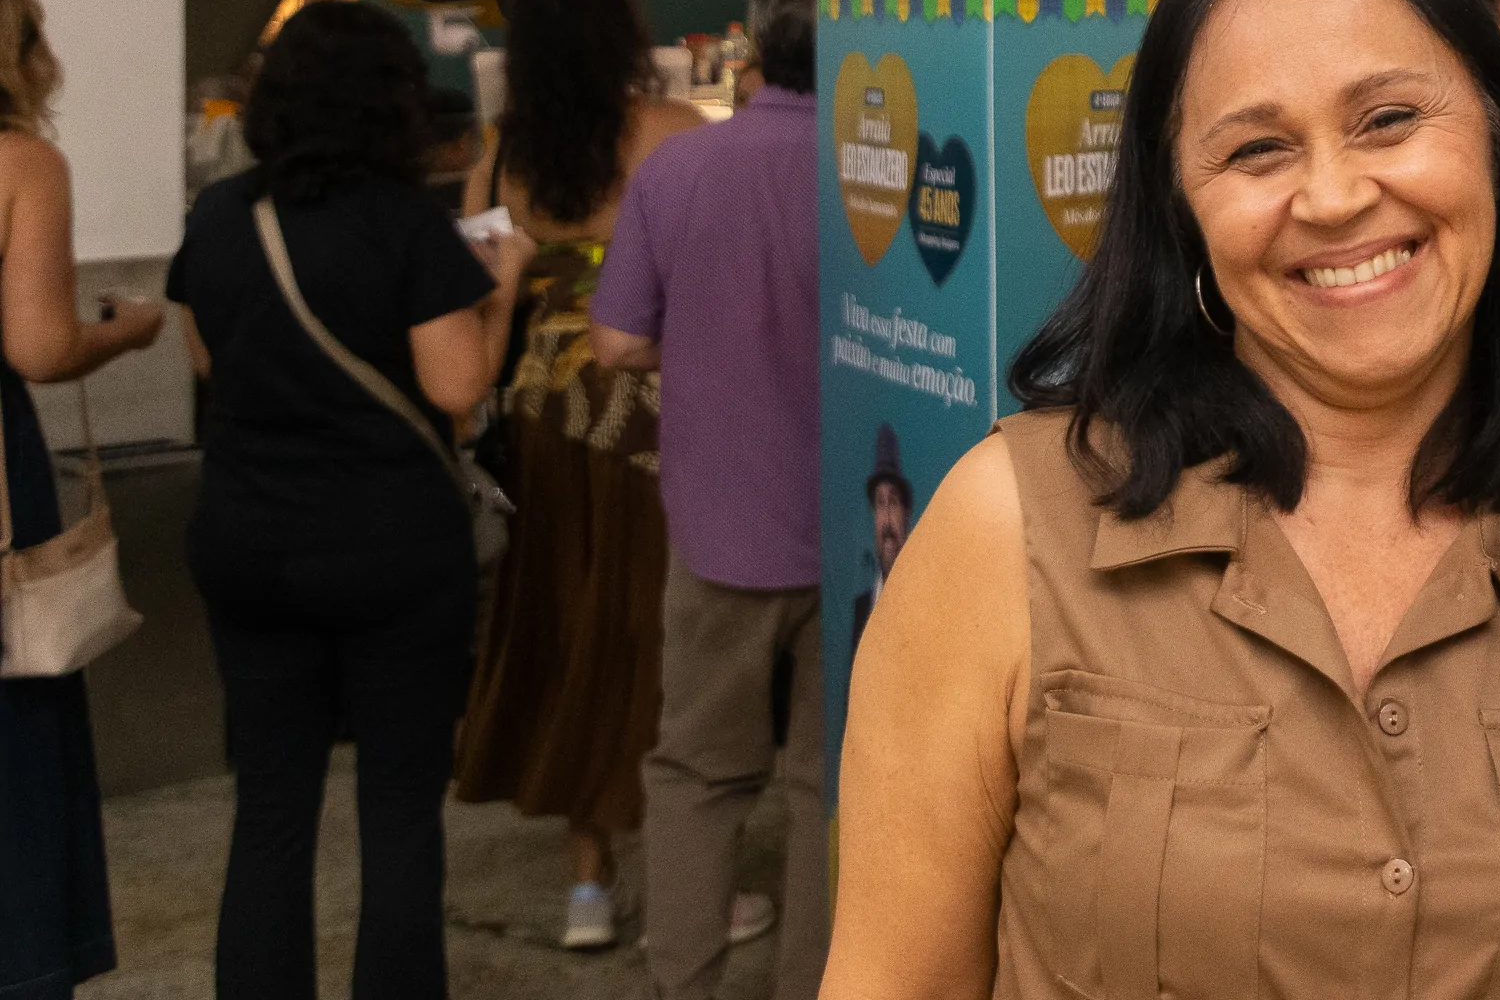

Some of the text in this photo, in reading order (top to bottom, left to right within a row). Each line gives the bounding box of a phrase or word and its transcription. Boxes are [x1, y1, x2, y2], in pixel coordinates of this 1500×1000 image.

[924, 162, 956, 187] Especial
[1044, 153, 1076, 198] LEO
[918, 185, 933, 223] 45
[933, 189, 961, 228] ANOS
[841, 291, 869, 332] Viva
[890, 307, 928, 349] festa
[930, 330, 957, 358] com
[911, 362, 978, 407] emoção.
